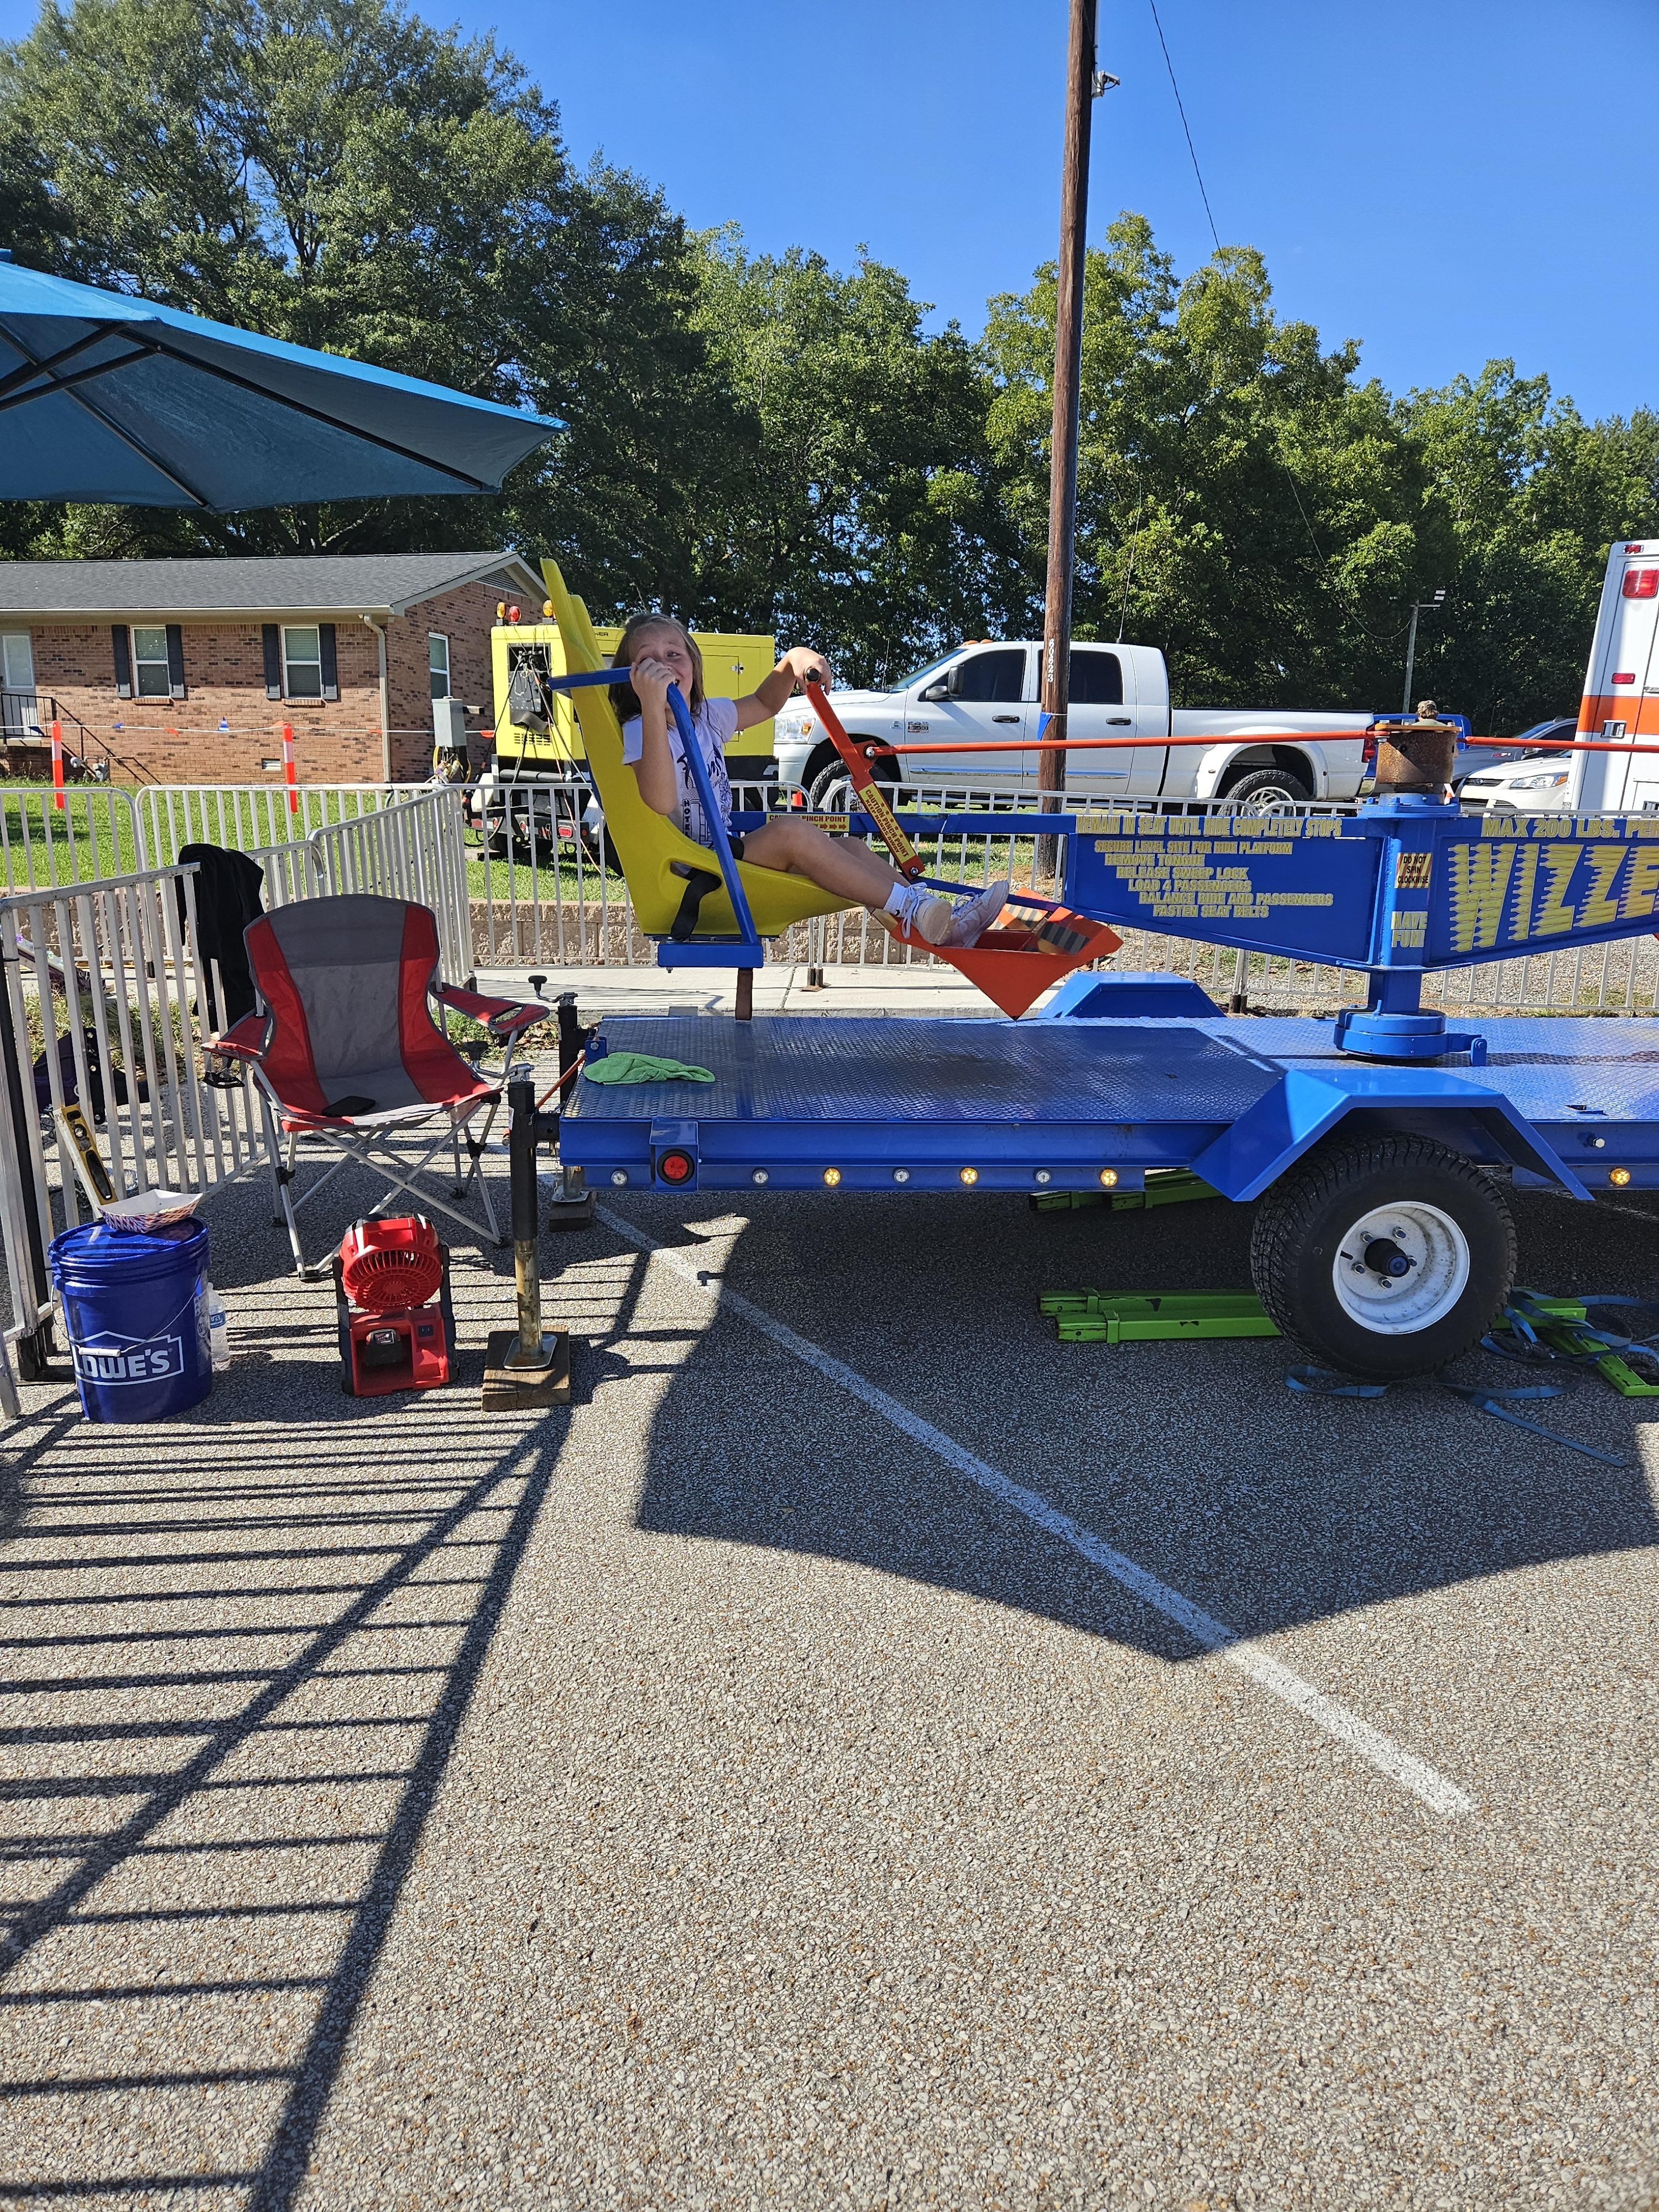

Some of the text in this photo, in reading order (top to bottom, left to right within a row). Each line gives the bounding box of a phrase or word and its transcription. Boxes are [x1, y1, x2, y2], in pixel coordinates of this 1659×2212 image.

[865, 789, 909, 857] CAUTION PINCH POINT
[865, 799, 900, 853] KEEP HANDS AWAY
[1076, 815, 1342, 837] REMAIN IN SEAT UNTIL RIDE COMPLETELY STOPS
[1481, 818, 1531, 837] MAX
[1532, 818, 1572, 838] 200
[1575, 818, 1620, 838] LBS.
[1094, 840, 1293, 854] SECURE LEVEL SITE FOR RIDE PLATFORM
[1105, 853, 1205, 867] REMOVE TONGUE
[1116, 866, 1249, 880] RELEASE SWEEP LOCK
[1407, 865, 1421, 874] SPIN
[1128, 879, 1252, 893] LOAD 4 PASSENGERS
[1397, 875, 1429, 884] CLOCKWISE
[1139, 891, 1333, 906] BALANCE RIDE AND PASSENGERS
[1448, 843, 1659, 952] WIZZE
[1152, 905, 1269, 918] FASTEN SEAT BELTS
[1391, 911, 1428, 930] HAVE
[72, 1348, 170, 1379] LOWE'S
